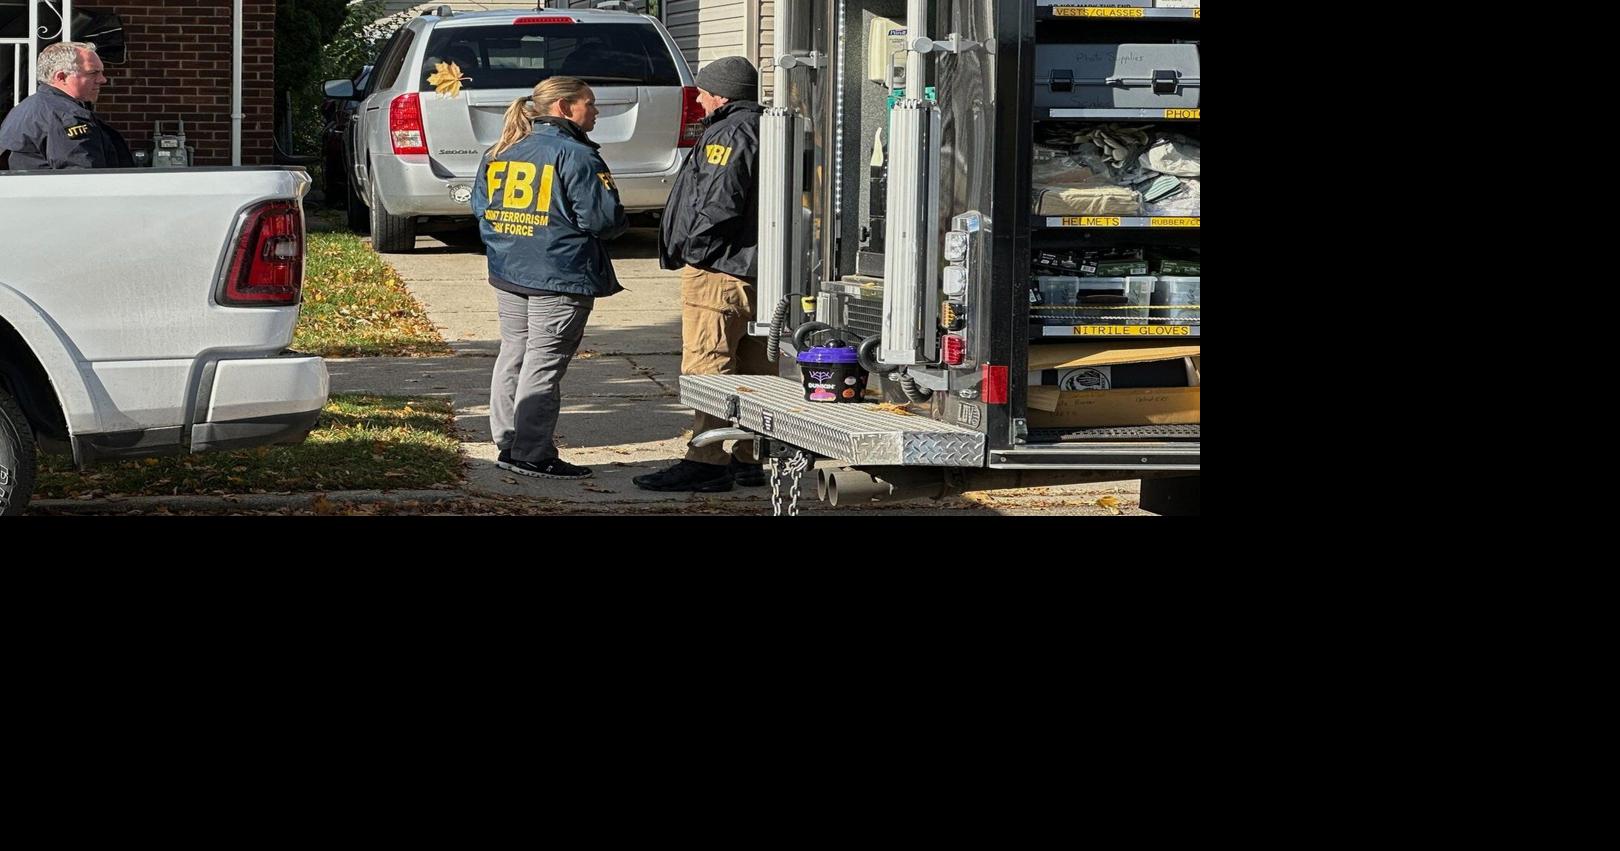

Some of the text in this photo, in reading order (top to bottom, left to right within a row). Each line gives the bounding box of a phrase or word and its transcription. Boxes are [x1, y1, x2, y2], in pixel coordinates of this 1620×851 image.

[1056, 8, 1142, 16] VESTS/GLASSES
[1166, 110, 1200, 118] PHOT
[67, 124, 88, 137] JTTF
[486, 161, 554, 212] FBI
[500, 211, 549, 226] TERRORISM
[1062, 217, 1119, 226] HELMETS
[504, 224, 534, 236] FORCE
[1073, 325, 1188, 335] NITRILE GLOVES
